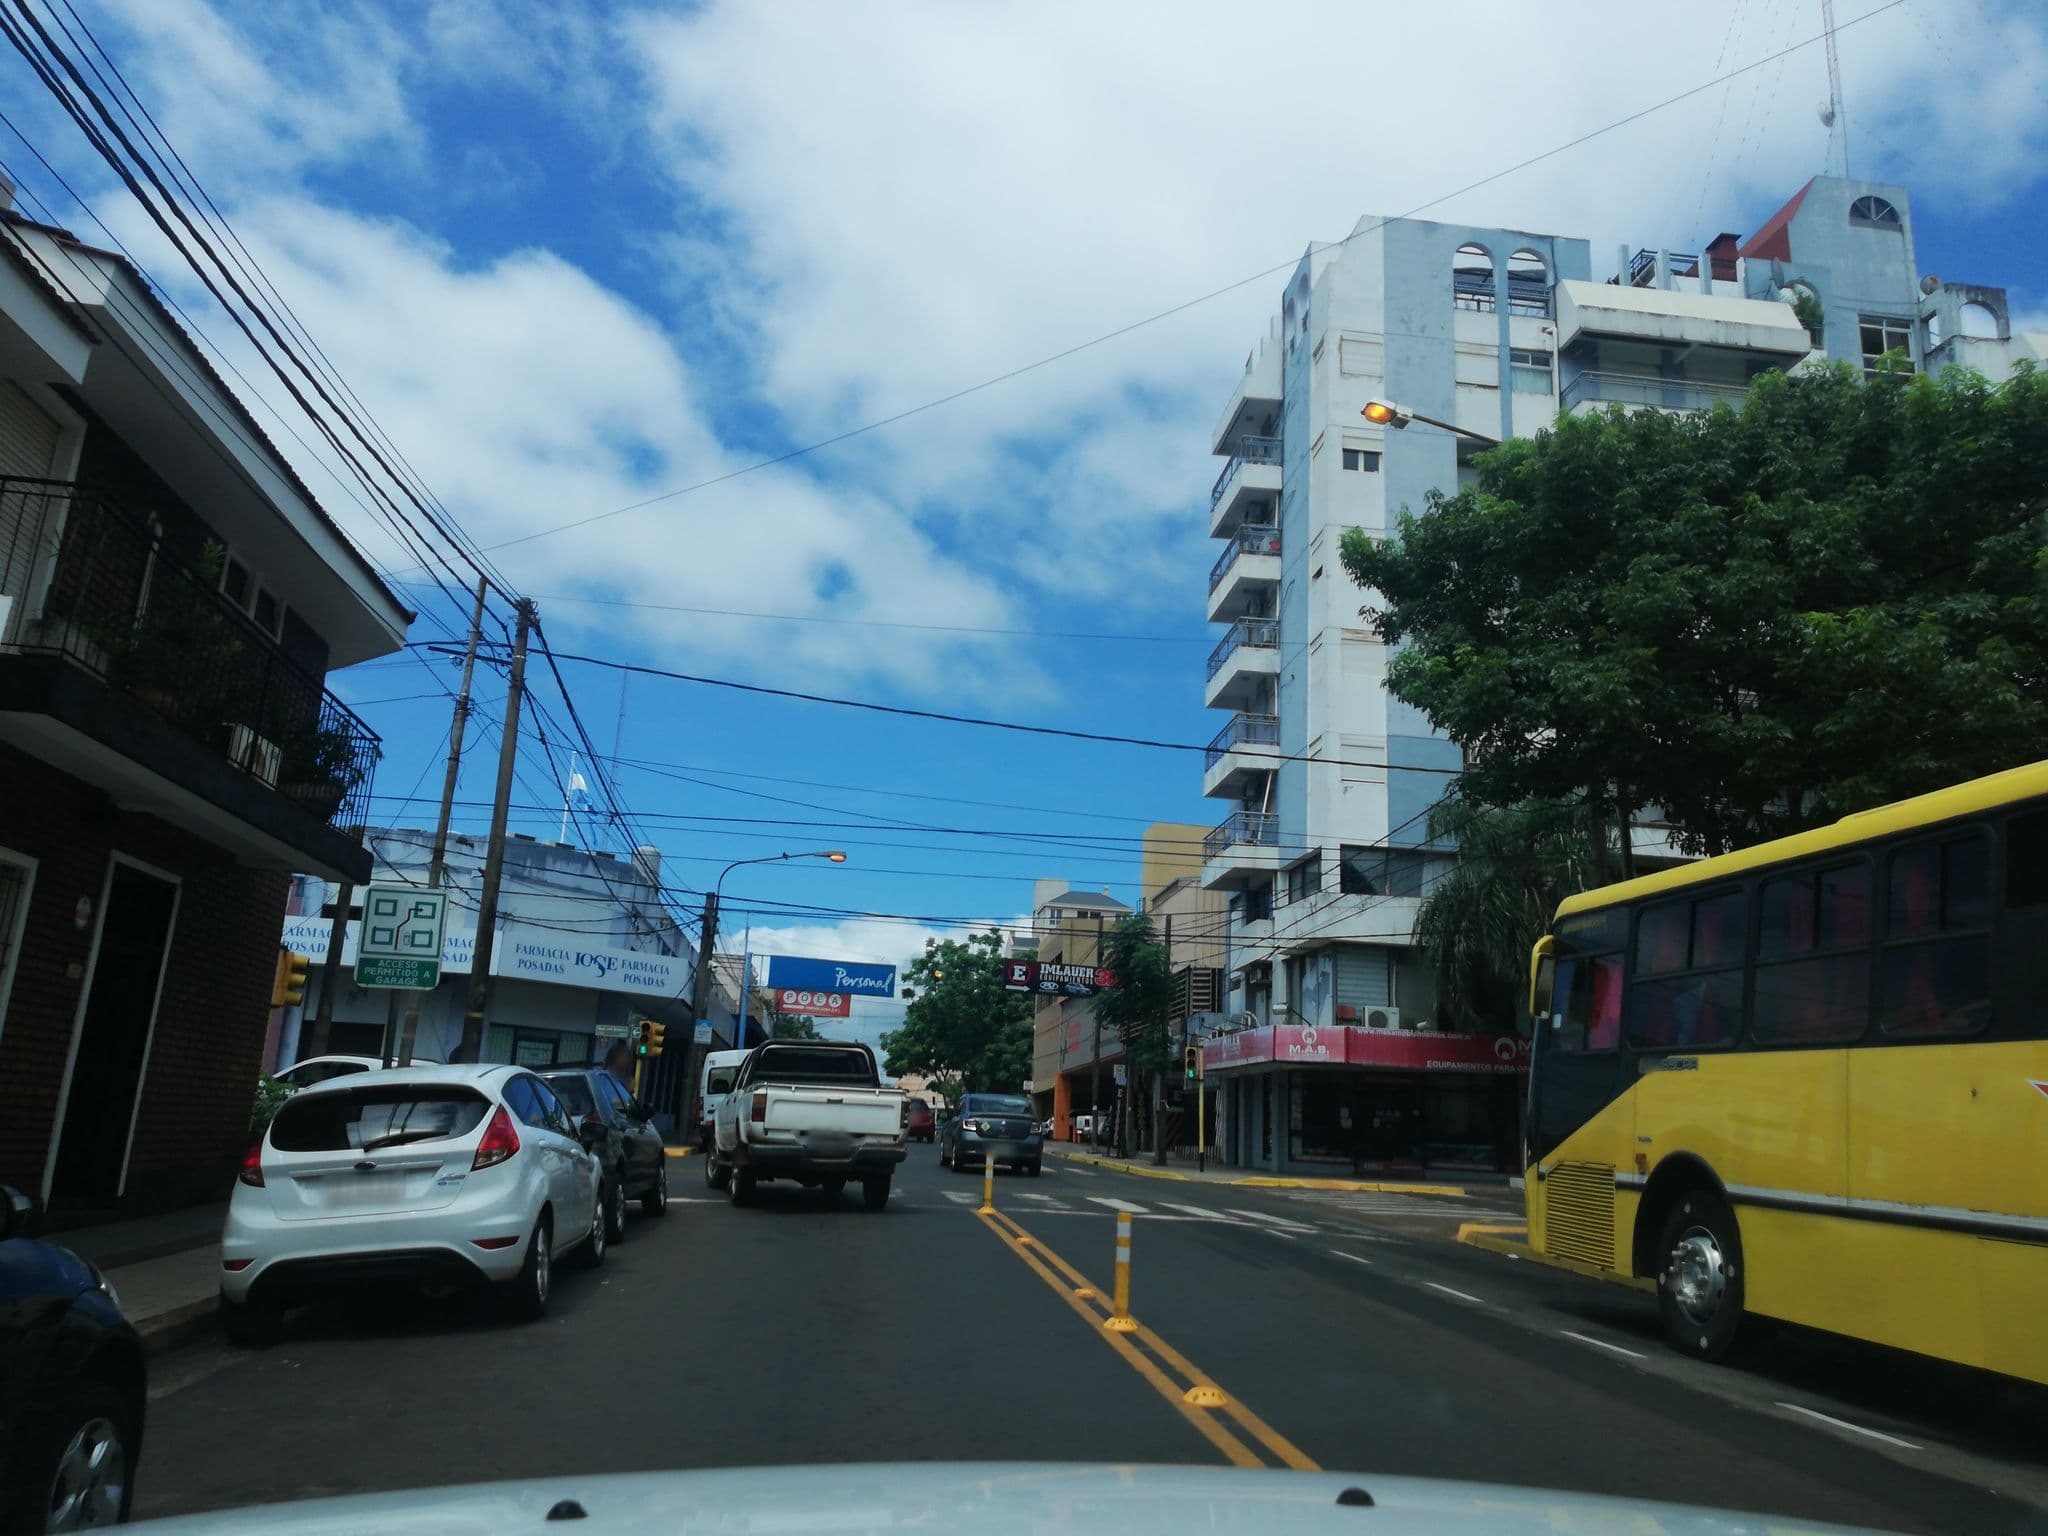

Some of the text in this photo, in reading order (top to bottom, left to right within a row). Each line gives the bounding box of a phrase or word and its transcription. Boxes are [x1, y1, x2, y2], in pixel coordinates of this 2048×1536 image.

[515, 943, 570, 961] FARMACIA
[377, 959, 418, 969] ACCESO
[517, 958, 565, 974] POSADAS
[574, 951, 618, 978] IOSE
[621, 959, 670, 976] FARMACIA
[1039, 963, 1095, 978] IMLAUER
[364, 967, 430, 978] PERMITIDO A
[835, 967, 894, 992] Personal
[1012, 965, 1027, 981] E
[1039, 974, 1094, 985] EQUIPAMIENTOS
[375, 976, 417, 986] GARAGE
[623, 973, 665, 988] POSADAS
[1426, 1060, 1492, 1073] EQUIPAMIENTOS
[1494, 1064, 1516, 1073] PARA
